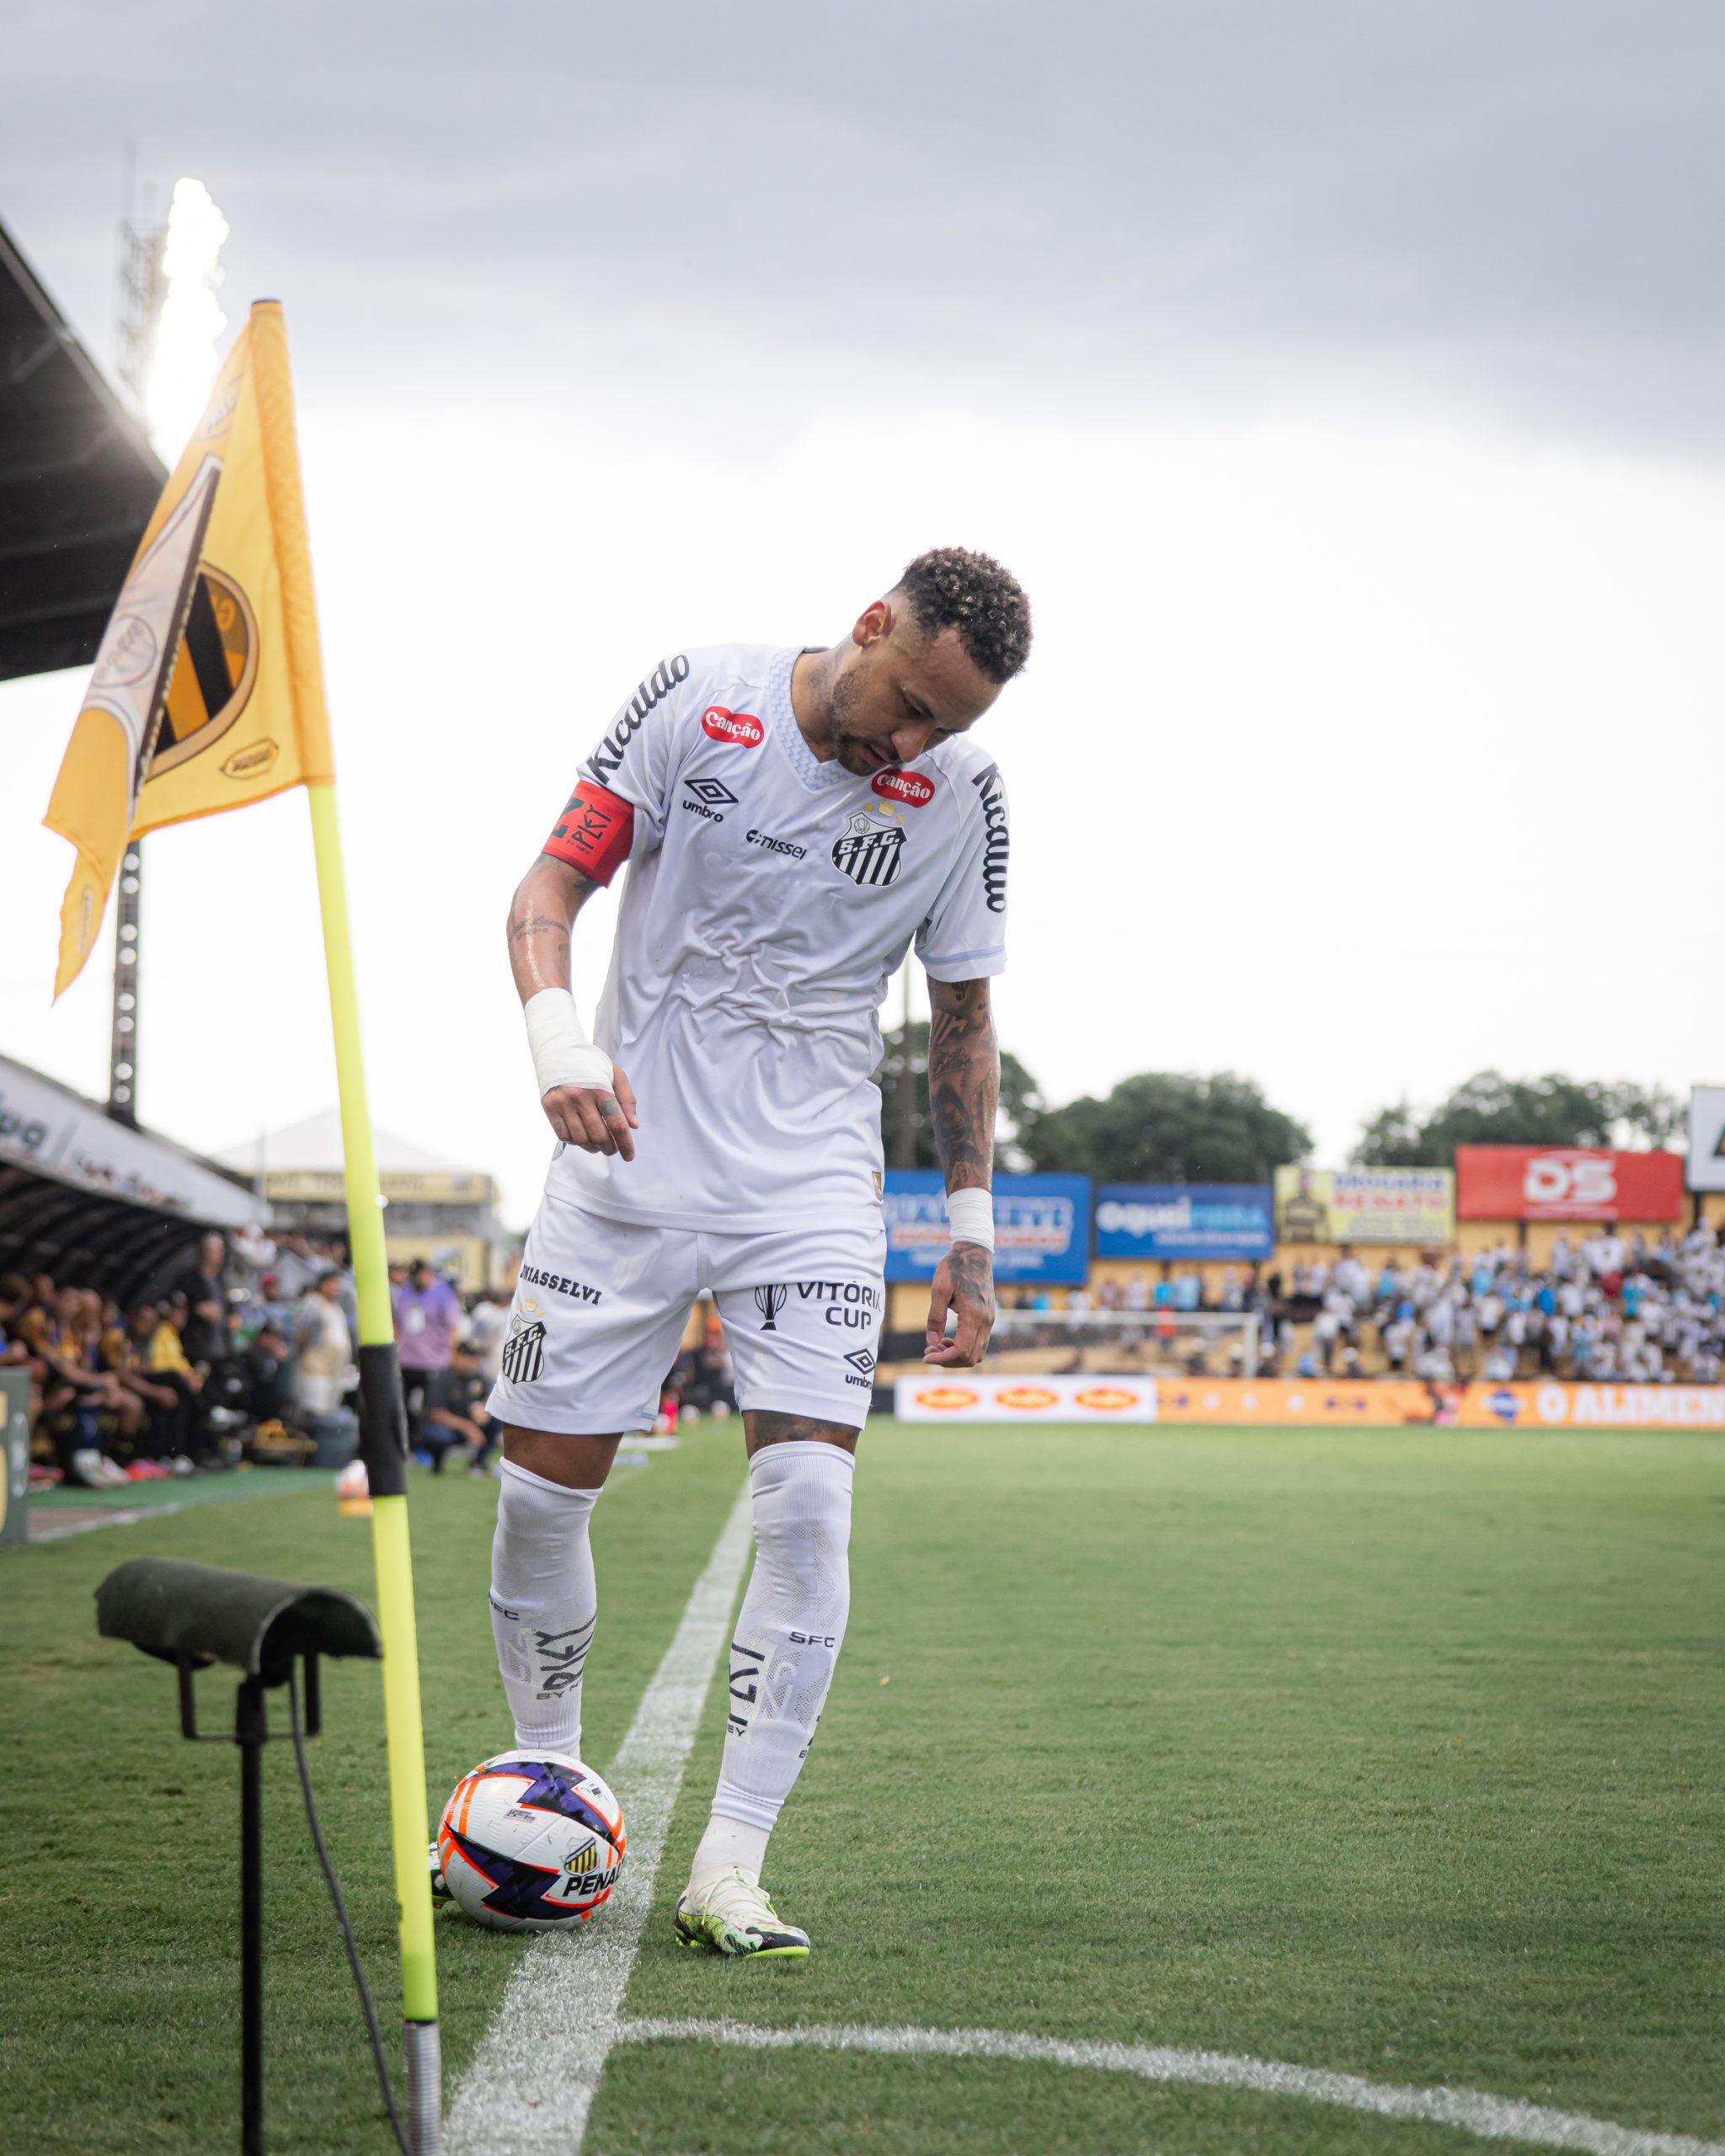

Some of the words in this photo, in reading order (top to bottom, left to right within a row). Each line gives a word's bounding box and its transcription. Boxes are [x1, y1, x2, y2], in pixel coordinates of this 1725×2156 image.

[705, 711, 761, 740] Canção
[877, 774, 931, 799] Canção
[682, 800, 724, 823] umbro
[1524, 1159, 1618, 1202] DS
[825, 1306, 871, 1330] CUP
[845, 1374, 872, 1390] umbr
[788, 1631, 835, 1648] SFC
